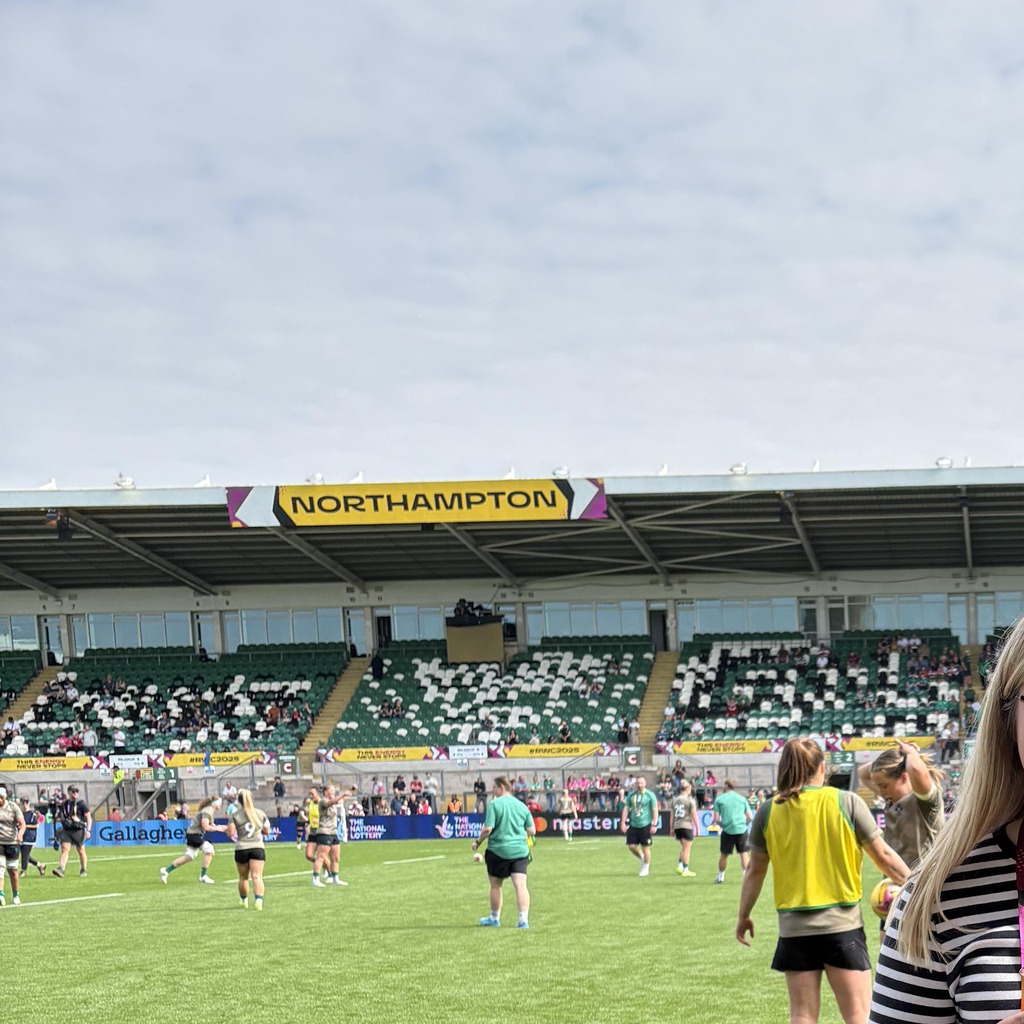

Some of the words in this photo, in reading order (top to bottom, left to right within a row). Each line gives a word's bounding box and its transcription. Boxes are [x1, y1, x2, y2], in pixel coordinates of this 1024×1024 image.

[291, 490, 557, 514] NORTHAMPTON
[627, 754, 638, 765] C
[845, 753, 853, 762] 2
[169, 768, 175, 779] 1
[283, 763, 293, 773] C
[454, 815, 468, 824] THE
[99, 825, 188, 844] Gallaghe
[243, 821, 256, 838] 9
[350, 831, 384, 839] LOTTERY
